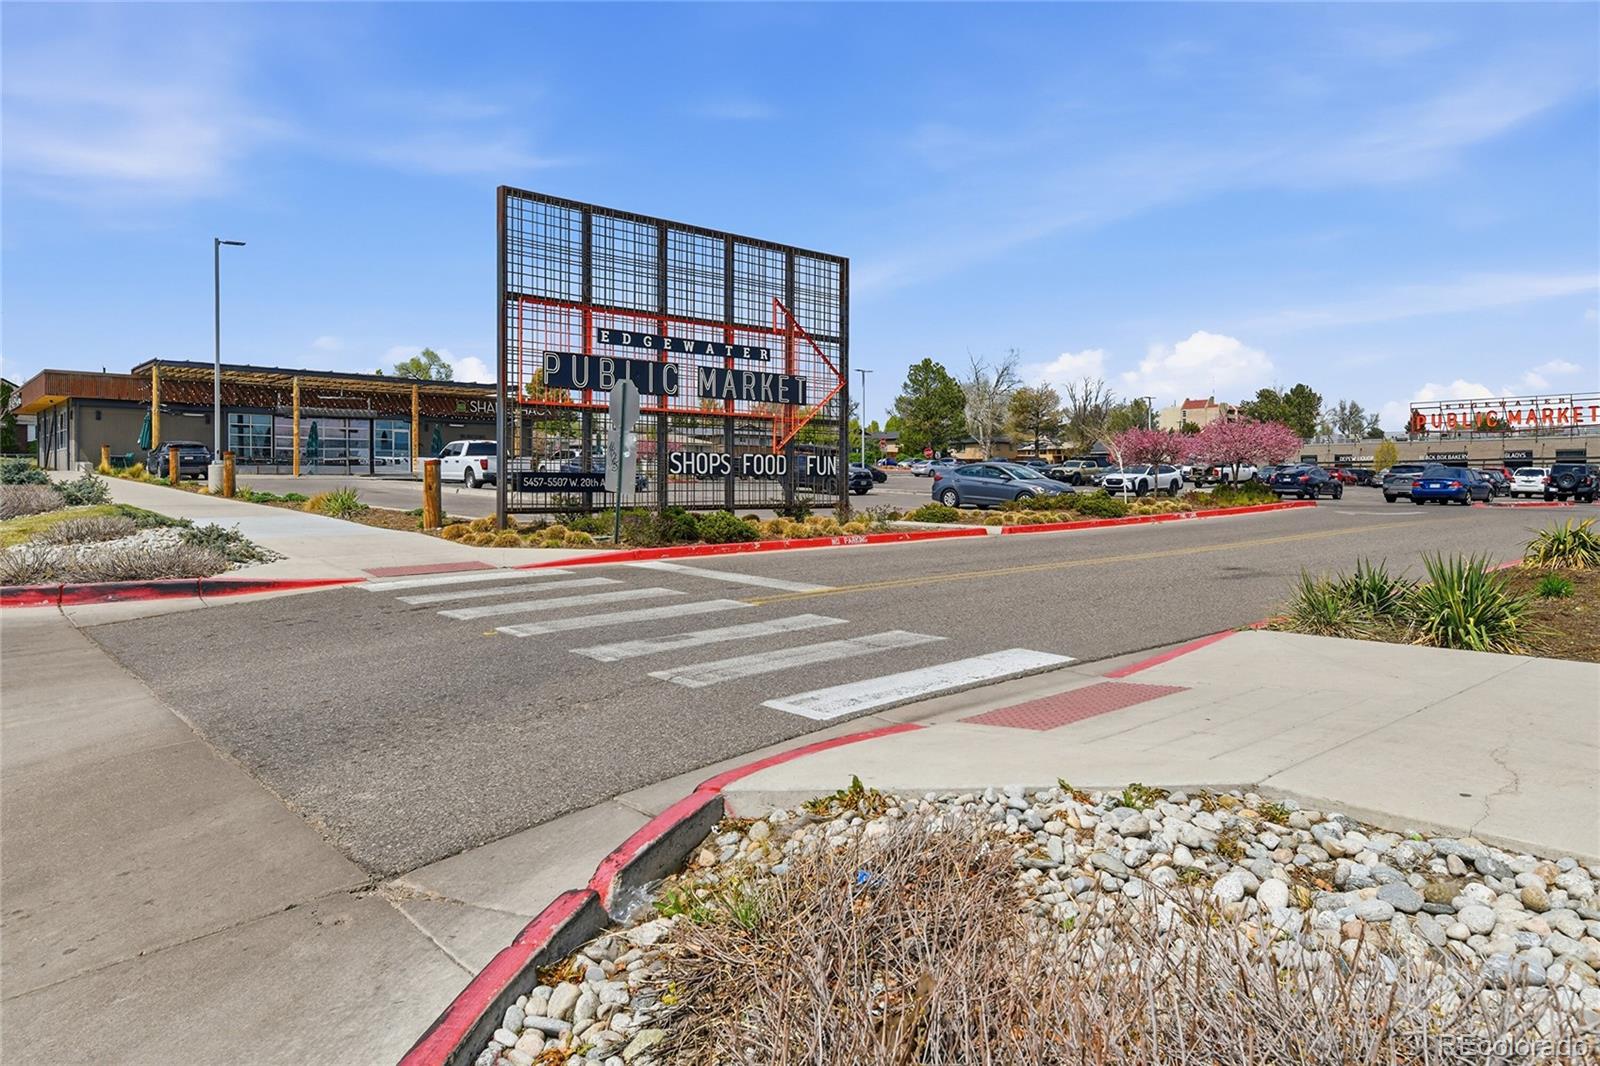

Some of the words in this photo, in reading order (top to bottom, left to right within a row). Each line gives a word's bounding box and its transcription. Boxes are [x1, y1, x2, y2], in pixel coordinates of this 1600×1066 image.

[600, 330, 769, 361] EDGEWATER
[699, 366, 807, 404] MARKET
[1415, 410, 1498, 430] PUBLIC
[1508, 405, 1600, 425] MARKET
[670, 452, 731, 475] SHOPS
[743, 454, 786, 475] FOOD
[806, 455, 837, 476] FUN
[523, 477, 568, 487] 5457-5507
[569, 478, 579, 487] W.
[580, 477, 599, 487] 20th
